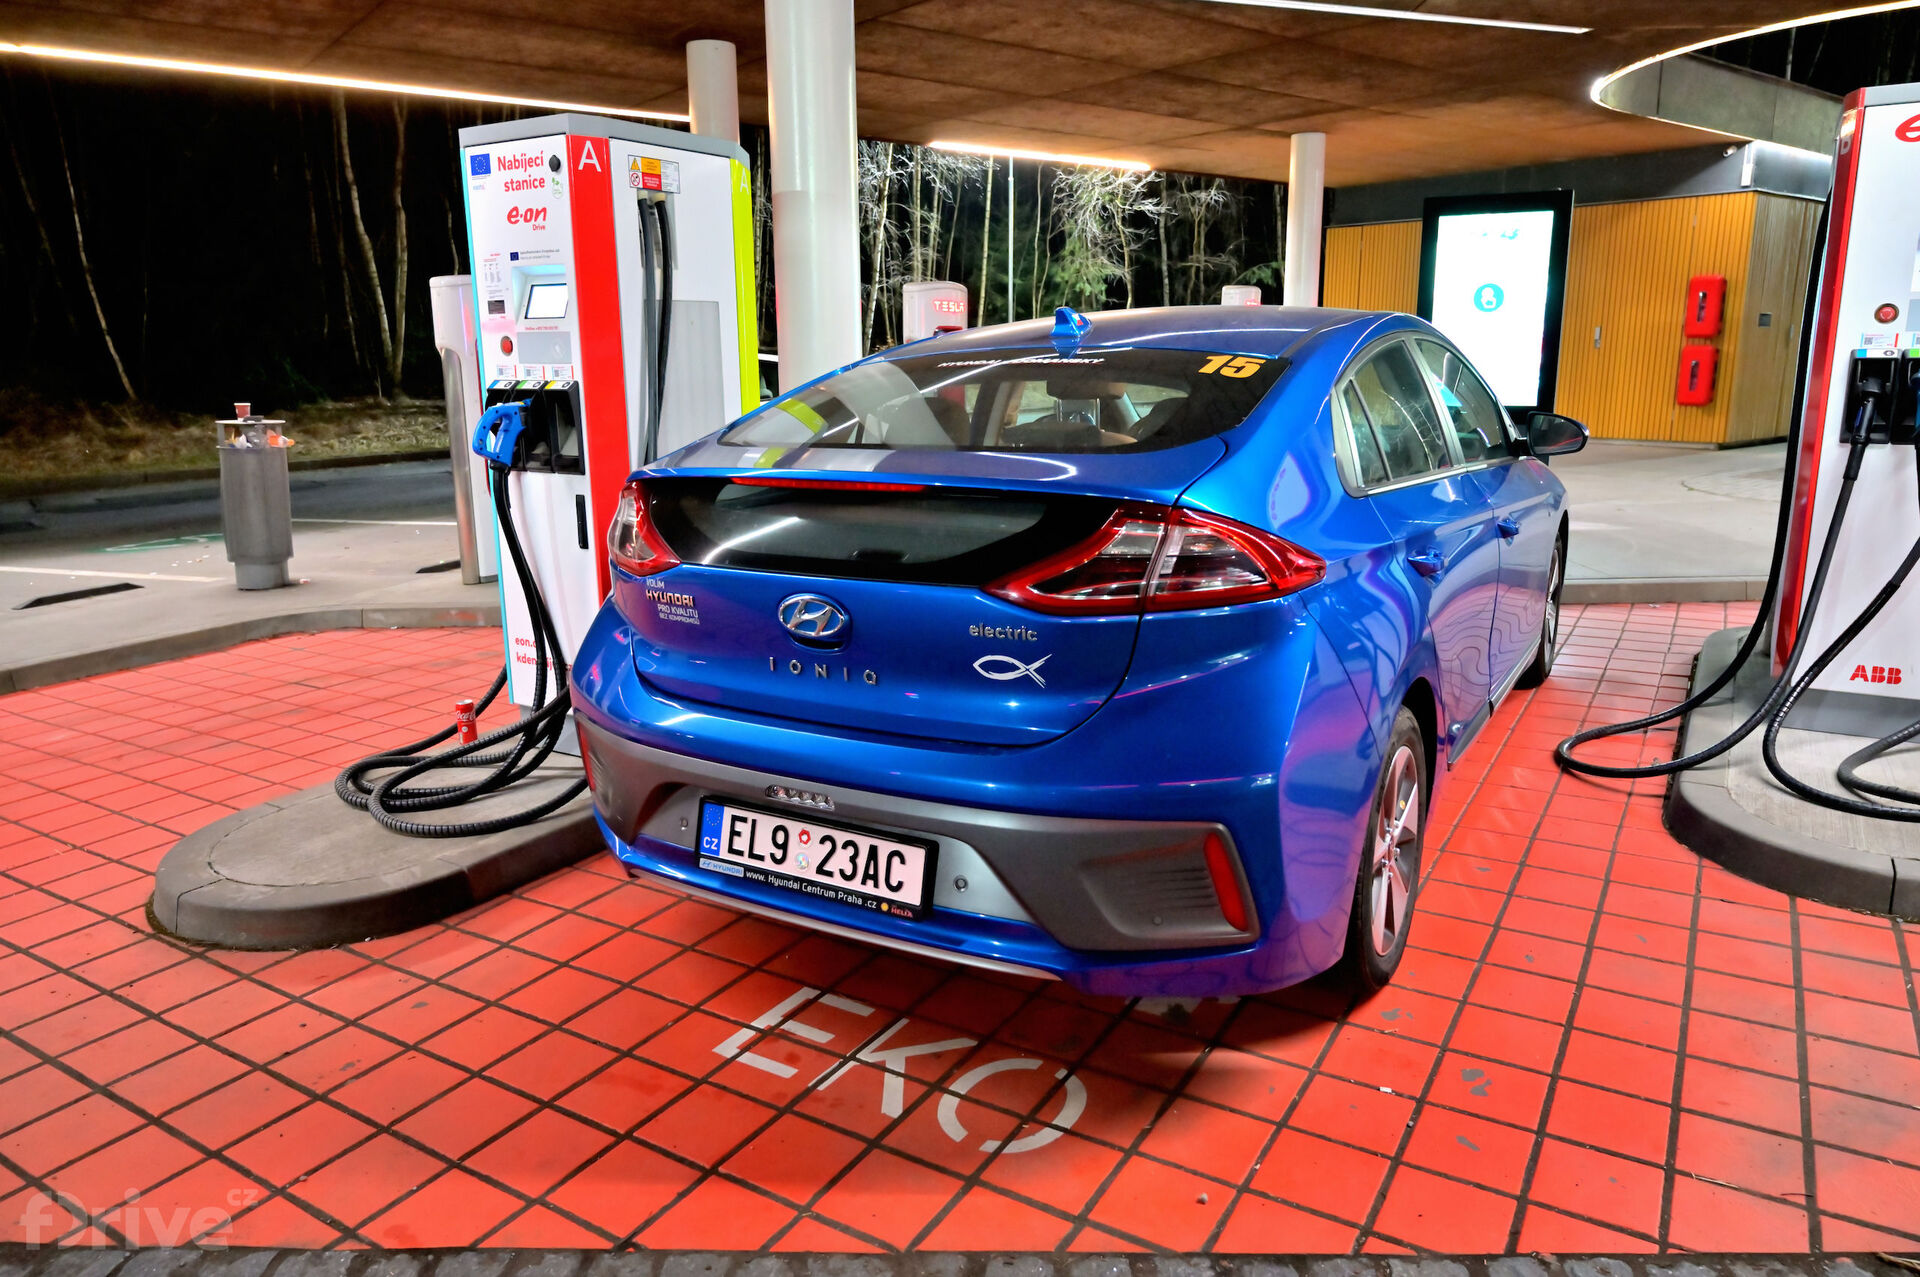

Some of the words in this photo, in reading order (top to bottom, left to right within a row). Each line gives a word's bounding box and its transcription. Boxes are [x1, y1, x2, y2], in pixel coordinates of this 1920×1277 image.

[497, 150, 544, 173] Nabíjecí
[578, 140, 602, 172] A
[504, 174, 546, 192] stanice
[740, 167, 749, 195] A
[934, 301, 965, 312] TESLA
[1198, 354, 1267, 379] 15
[645, 589, 694, 608] HYUNDAI
[657, 604, 671, 614] PRO
[671, 606, 699, 618] KVALITU
[968, 622, 1038, 641] electric
[515, 637, 537, 649] eon.c
[769, 656, 877, 685] IONIQ
[1849, 664, 1902, 685] ABB
[702, 835, 719, 850] CZ
[727, 814, 789, 865] EL9
[815, 834, 906, 893] 23AC
[712, 863, 744, 876] HYUNDAI
[745, 870, 766, 882] www.
[768, 874, 800, 890] Hyundai
[802, 883, 836, 899] Centrum
[838, 891, 863, 905] Praha
[864, 900, 877, 909] .cz
[712, 986, 1088, 1154] EKO
